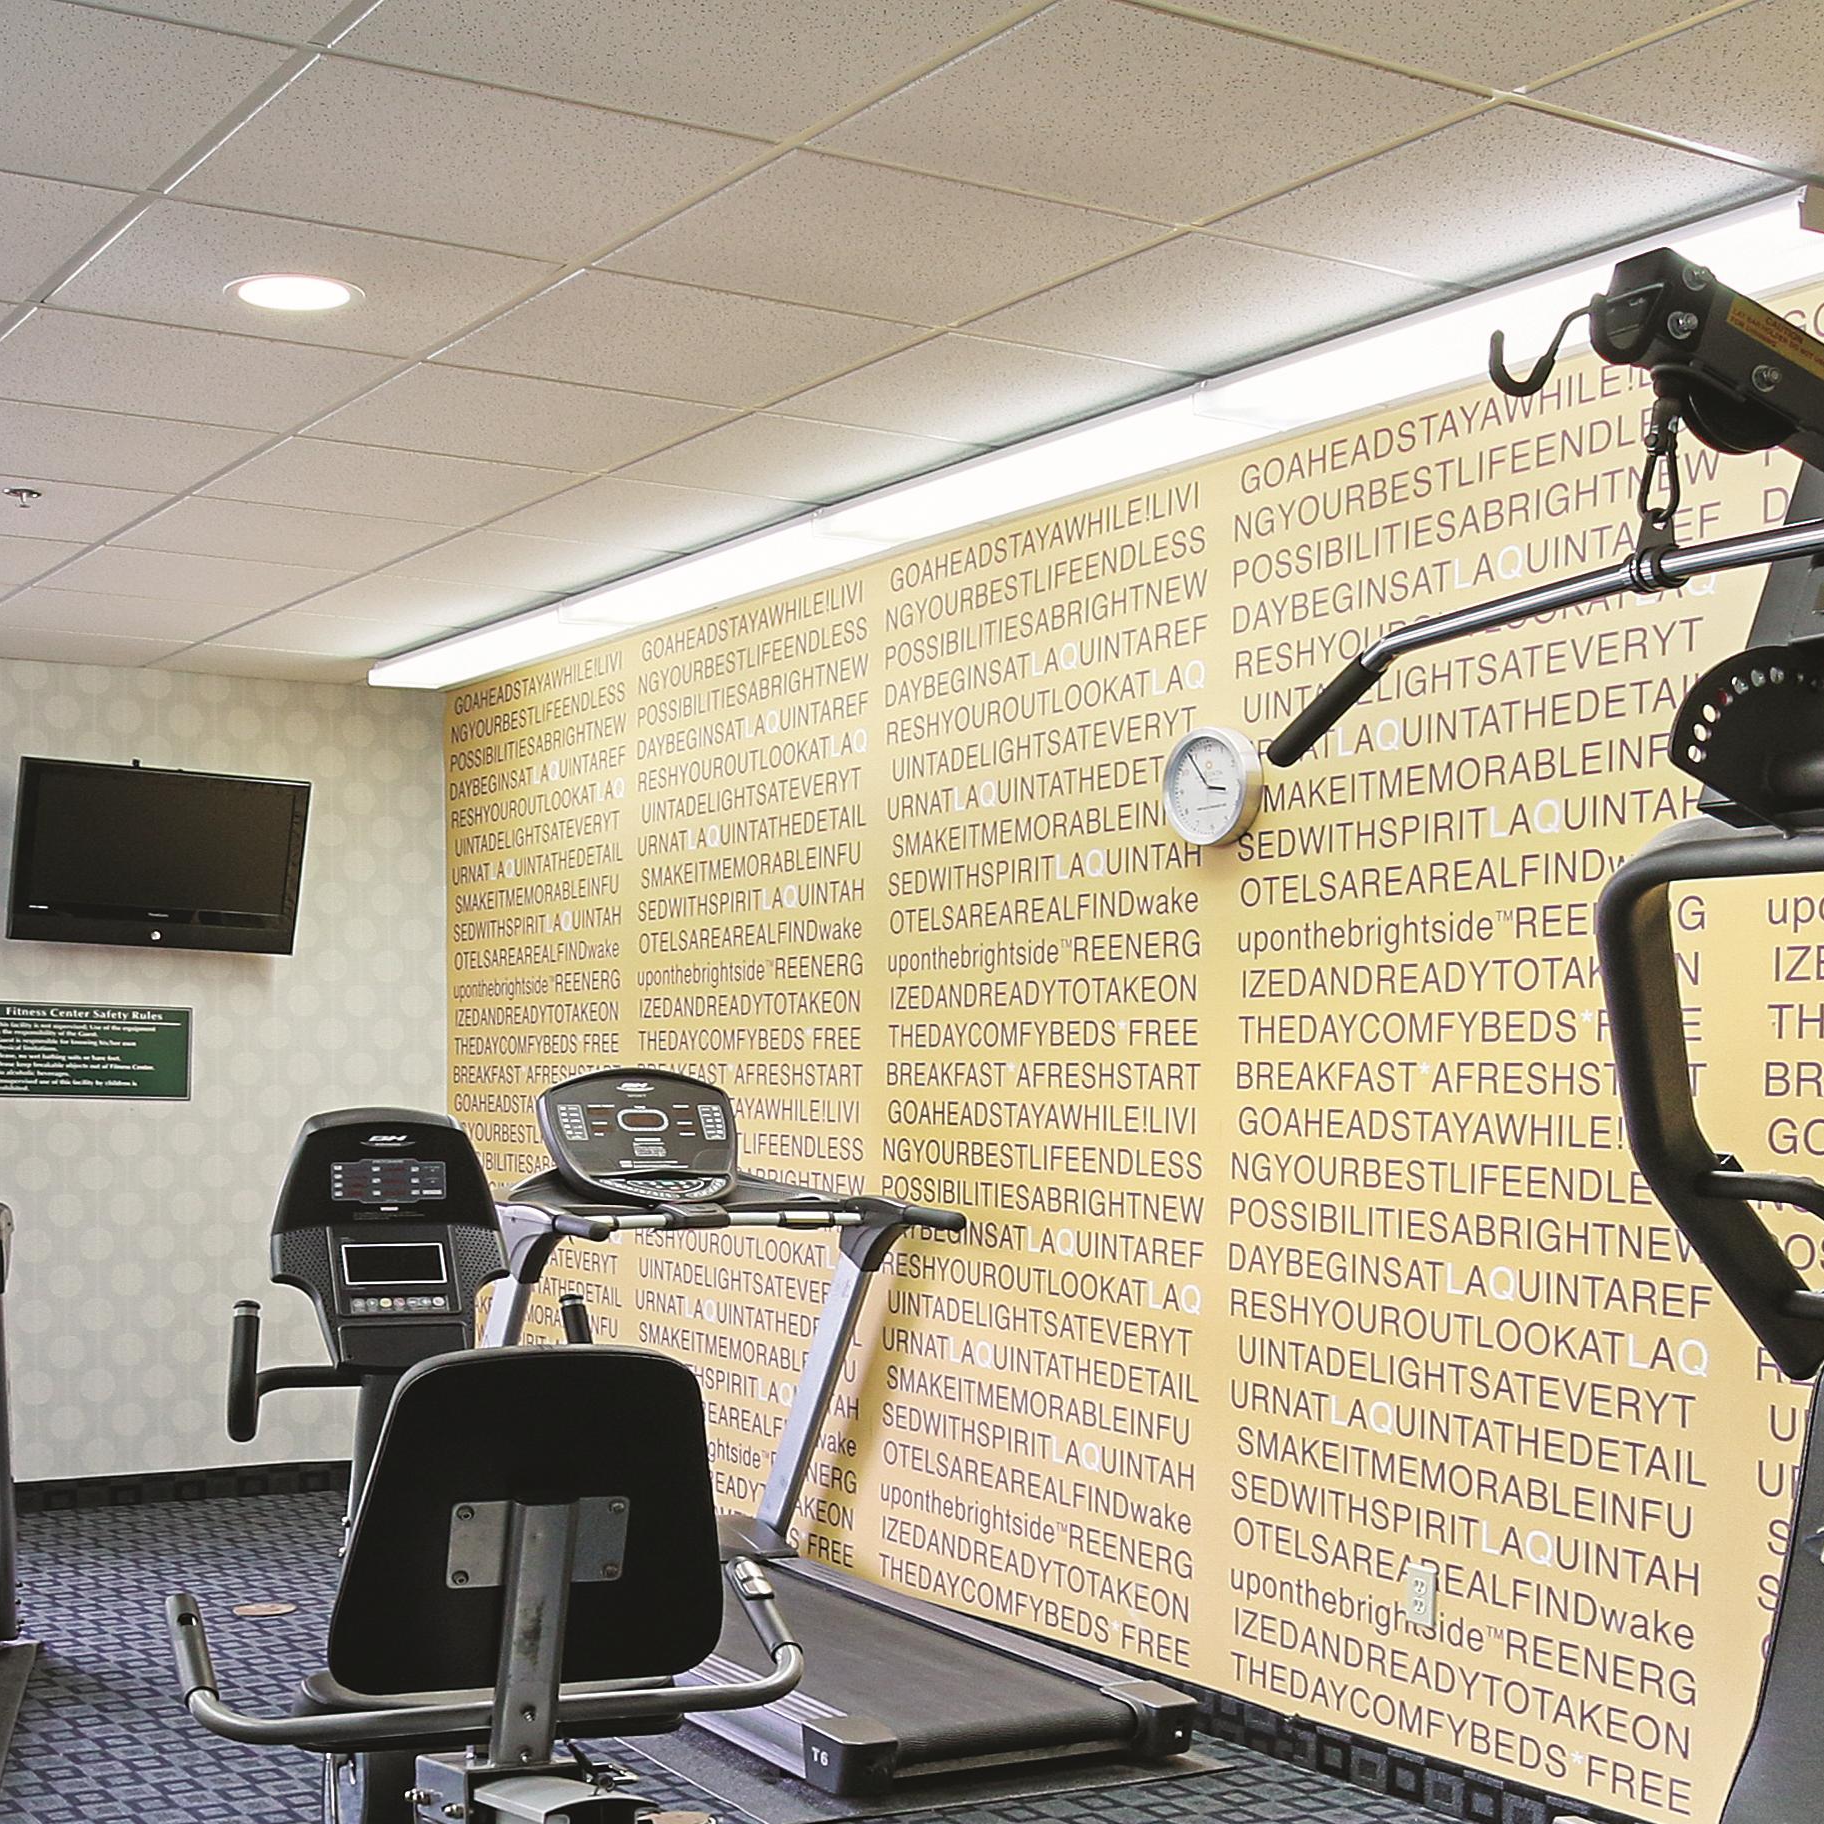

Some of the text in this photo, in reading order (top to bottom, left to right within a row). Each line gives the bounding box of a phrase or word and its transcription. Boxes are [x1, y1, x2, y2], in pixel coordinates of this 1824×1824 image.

[889, 479, 1201, 593] GOAHEADSTAYAWHILE!LIVI
[1232, 498, 1721, 635] DAYBEGINSATLAQUINTAEF
[885, 522, 1205, 632] NGYOURBESTLIFEENDLESS
[884, 567, 1208, 670] POSSIBILITIESABRIGHTNEW
[884, 612, 1208, 708] DAYBEGINSATLAQUINTAREF
[885, 657, 1205, 746] RESHYOUROUTLOOKATLAQ
[891, 704, 1197, 782] UINTADELIGHTSATEVERYT
[886, 754, 1160, 821] URNATLAQUINTATHEDET
[891, 797, 1166, 858] SMAKEITMEMORABLEIN
[888, 882, 1199, 935] OTELSAREAREALFINDwake
[6, 1006, 162, 1020] Fitness Center Safety Rules
[889, 972, 1197, 1010] IZEDANDREADYTOTAKEON
[886, 1099, 1197, 1134] GOAHEADSTAYAWHILE!LIVI
[1237, 1106, 1624, 1149] GOAHEADSTAYAWHILE!
[882, 1137, 1203, 1179] NGYOURBESTLIFEENDLESS
[1231, 1152, 1653, 1205] NGYOURBESTLIFEENDLE
[881, 1174, 1204, 1224] POSSIBILITIESABRIGHTNEW
[633, 1223, 836, 1269] RESHYOUROUTLOOKATL
[881, 1250, 1201, 1313] RESHYOUROUTLOOKATLAQ
[1228, 1242, 1712, 1320] DAYBEGINSATLAQUINTAREF
[886, 1288, 1193, 1357] UINTADELIGHTSATEVERYT
[1229, 1288, 1709, 1376] RESHYOUROUTLOOKATLAQ
[881, 1325, 1199, 1403] URNATLAQUINTATHEDETAIL
[1237, 1334, 1697, 1430] UINTADELIGHTSATEVERYT
[885, 1364, 1190, 1446] SMAKEITMEMORABLEINFU
[1230, 1378, 1707, 1487] URNATLAQUINTATHEDETAIL
[881, 1401, 1195, 1491] SEDWITHSPIRITLAQUINTAH
[1236, 1425, 1693, 1540] SMAKEITMEMORABLEINFU
[882, 1439, 1191, 1535] OTELSAREAREALFINDwake
[881, 1514, 1189, 1624] IZEDANDREADYTOTAKEON
[1230, 1469, 1700, 1597] SEDWITHSPIRITLAQUINTAH
[1233, 1606, 1691, 1761] IZEDANDREADYTOTAKEON
[811, 1750, 829, 1767] T6
